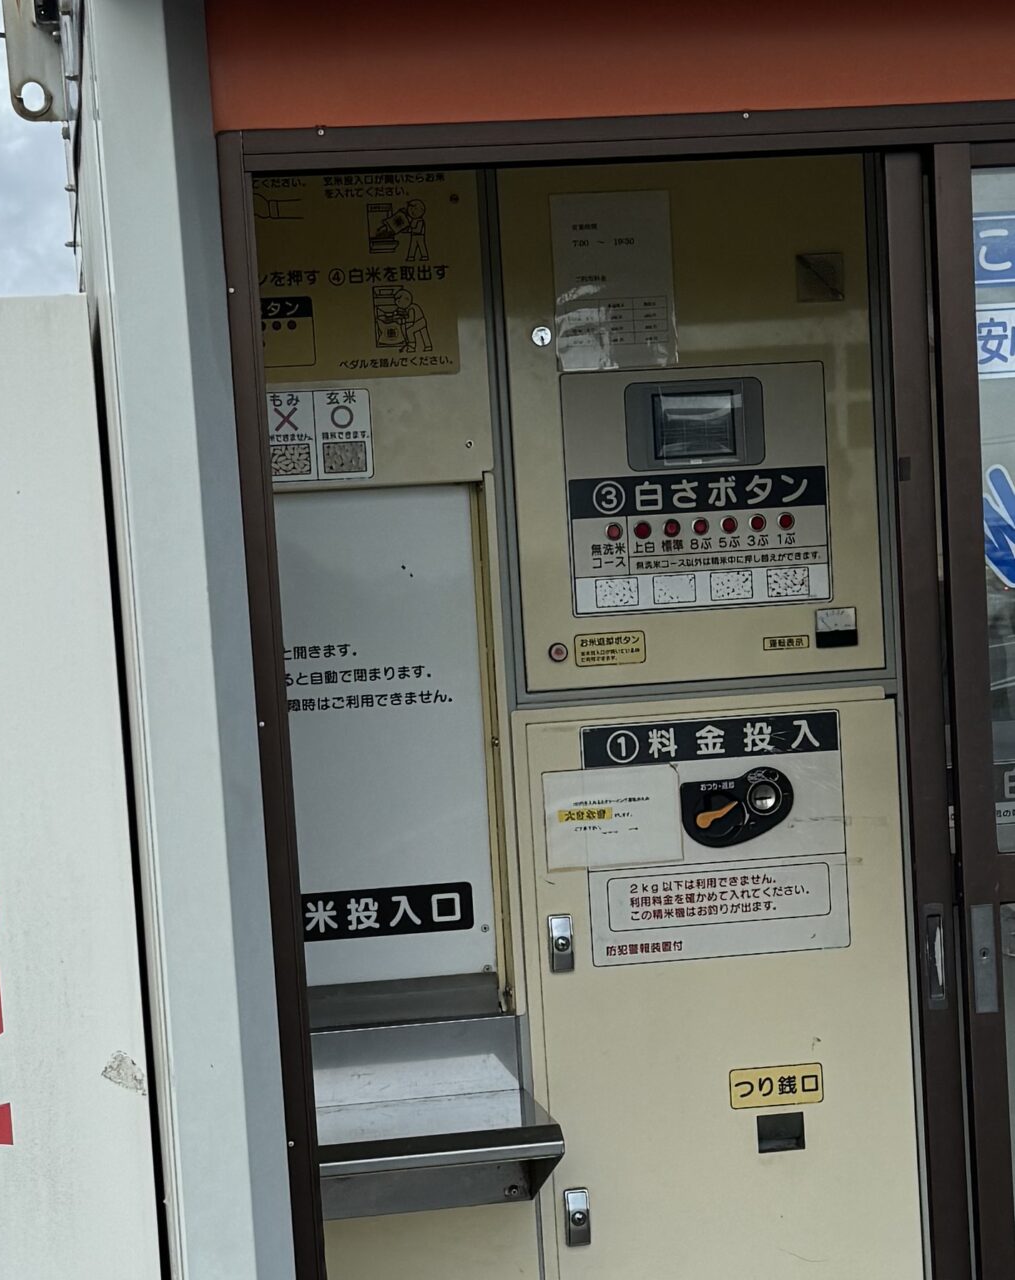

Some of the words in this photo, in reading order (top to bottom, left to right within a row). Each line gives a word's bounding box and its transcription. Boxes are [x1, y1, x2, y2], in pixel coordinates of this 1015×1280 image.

[977, 317, 1015, 365] 安
[270, 393, 300, 407] もみ
[326, 390, 357, 405] 玄米
[591, 542, 626, 556] 無洗米
[633, 541, 655, 554] 上白
[690, 538, 712, 550] 8ぶ
[719, 536, 741, 548] 5ぶ
[747, 535, 769, 547] 3ぶ
[777, 533, 796, 545] 1ぶ
[592, 556, 627, 569] コース
[304, 891, 461, 934] 米投入口
[734, 1074, 819, 1098] つり銭口
